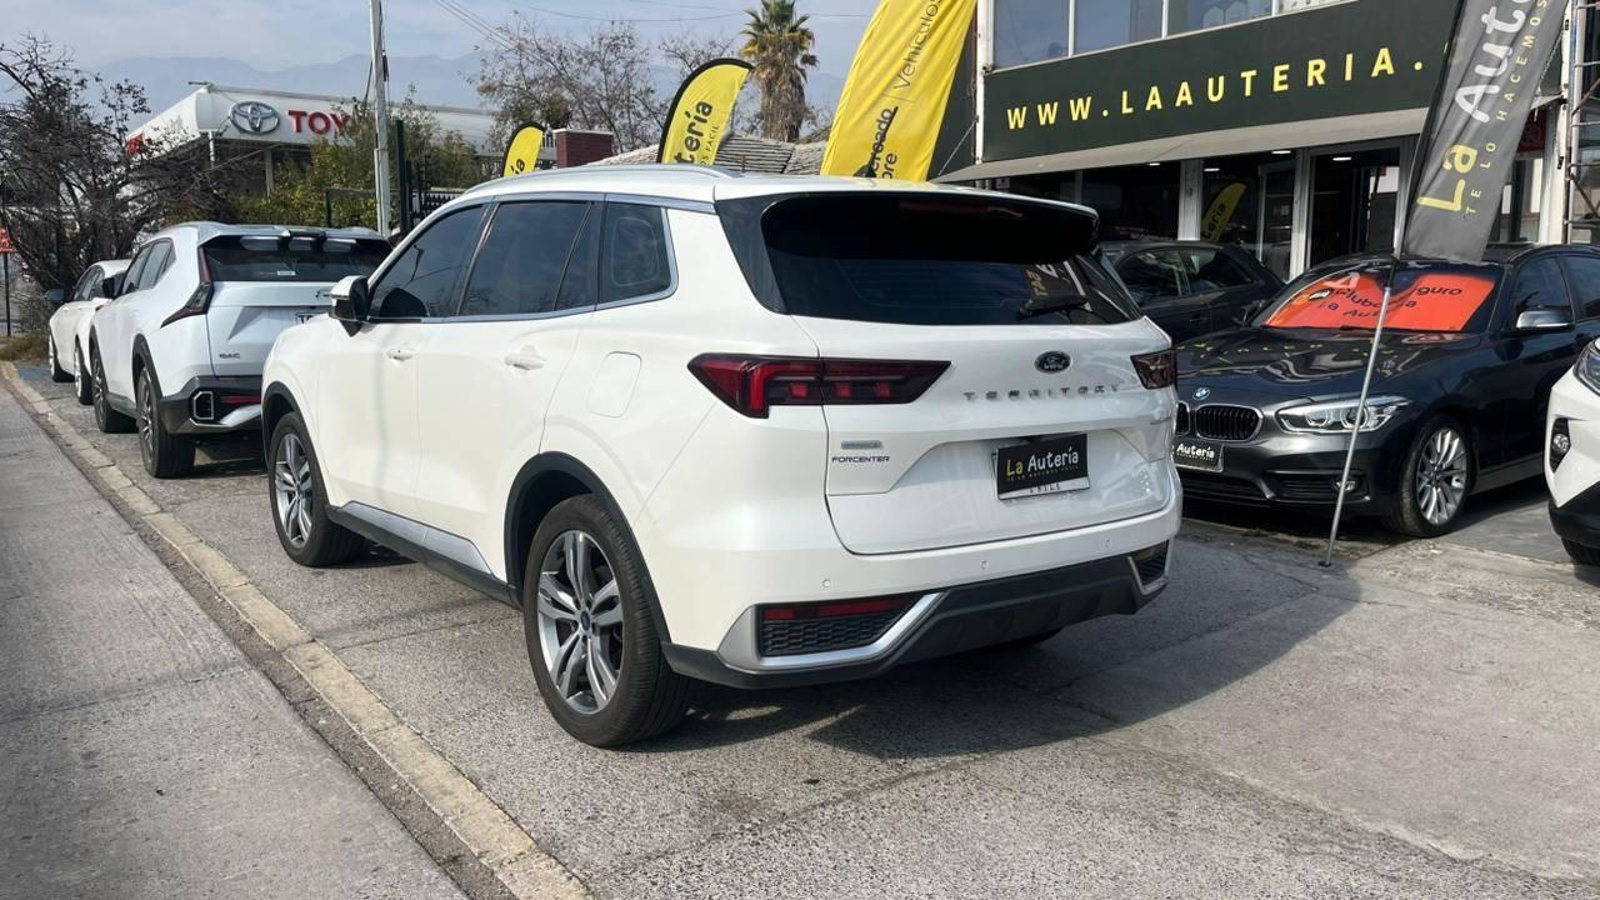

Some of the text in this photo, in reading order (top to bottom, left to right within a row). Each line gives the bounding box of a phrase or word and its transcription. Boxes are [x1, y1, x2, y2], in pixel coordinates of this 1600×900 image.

[1007, 46, 1425, 130] WWW.LAAUTERIA.
[1417, 0, 1531, 212] La Aut
[287, 109, 351, 136] TOY
[674, 101, 713, 164] tería
[1466, 188, 1482, 215] TE
[1480, 142, 1497, 169] LO
[963, 384, 1119, 401] TERRITORY
[832, 455, 890, 463] FORCENTER
[1006, 459, 1024, 476] La
[1027, 446, 1079, 472] Autería
